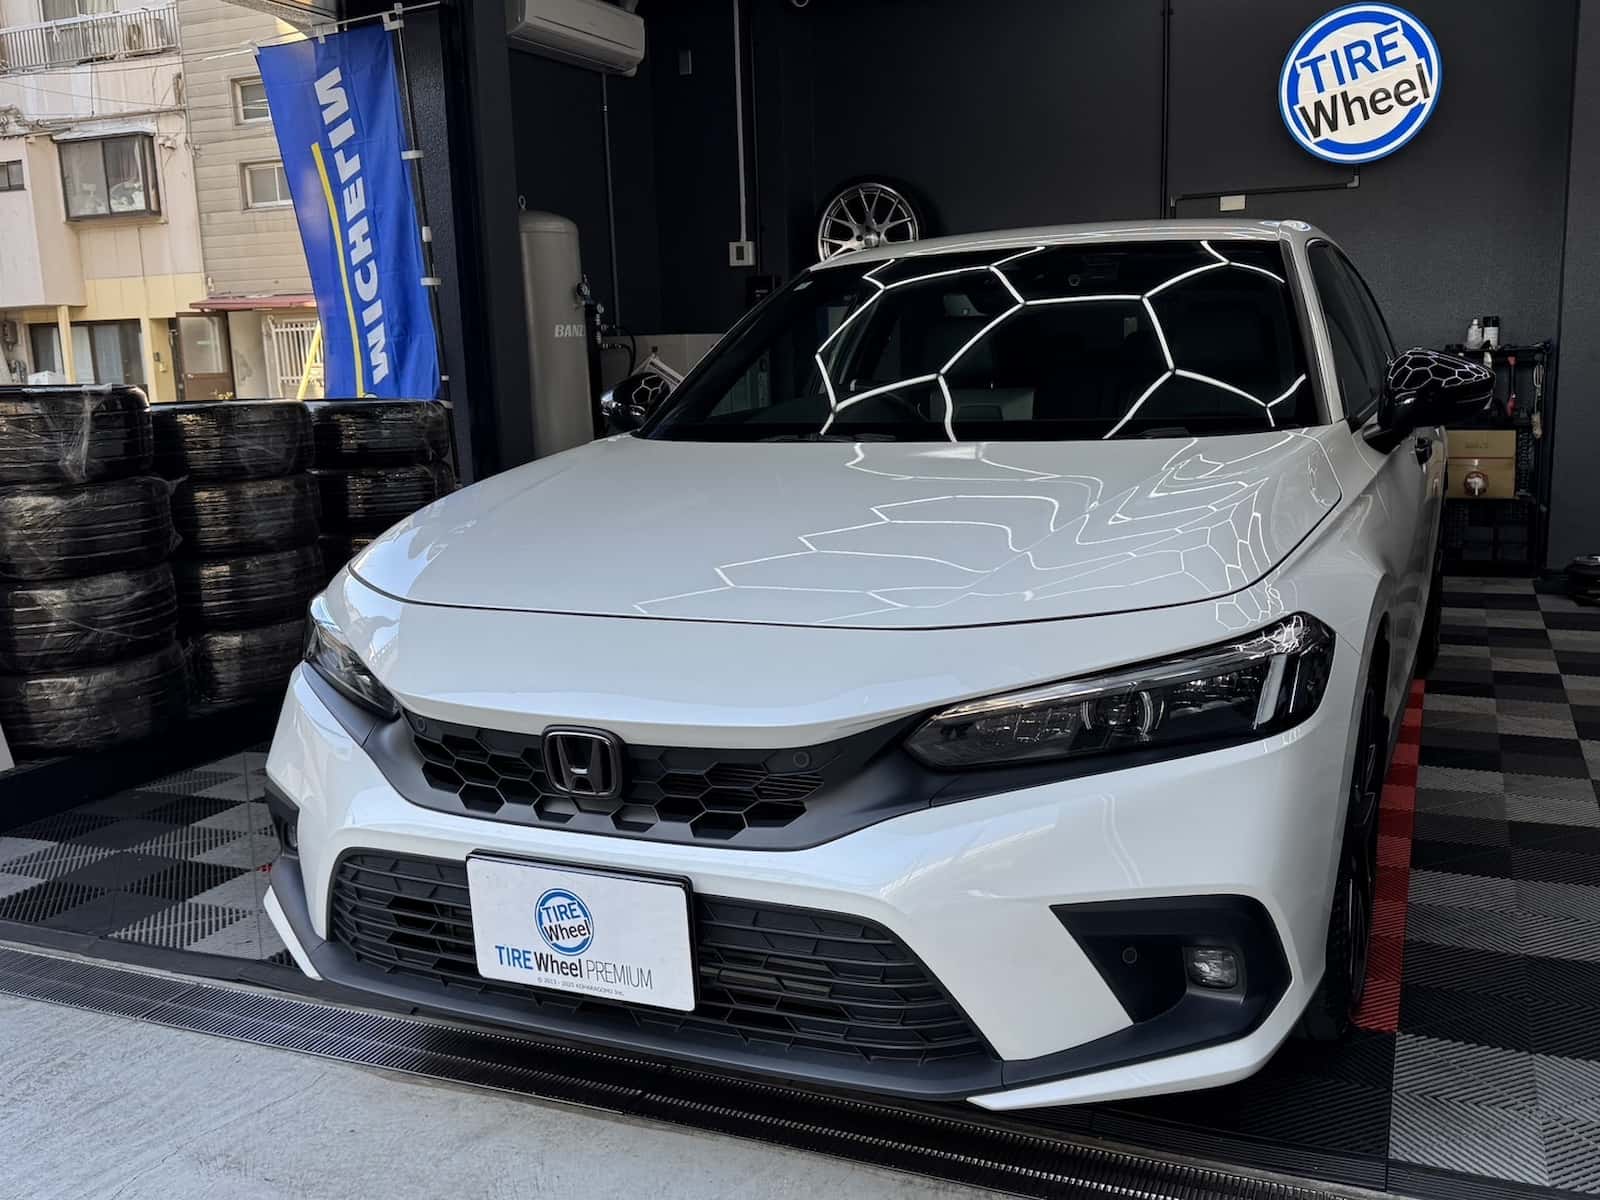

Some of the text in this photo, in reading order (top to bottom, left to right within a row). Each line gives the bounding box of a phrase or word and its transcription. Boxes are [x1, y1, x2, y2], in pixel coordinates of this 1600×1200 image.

[1300, 26, 1407, 94] TIRE
[1299, 63, 1431, 139] Wheel
[542, 902, 581, 923] TIRE
[544, 919, 591, 942] Wheel
[495, 945, 653, 990] TIRE Wheel PREMIUM
